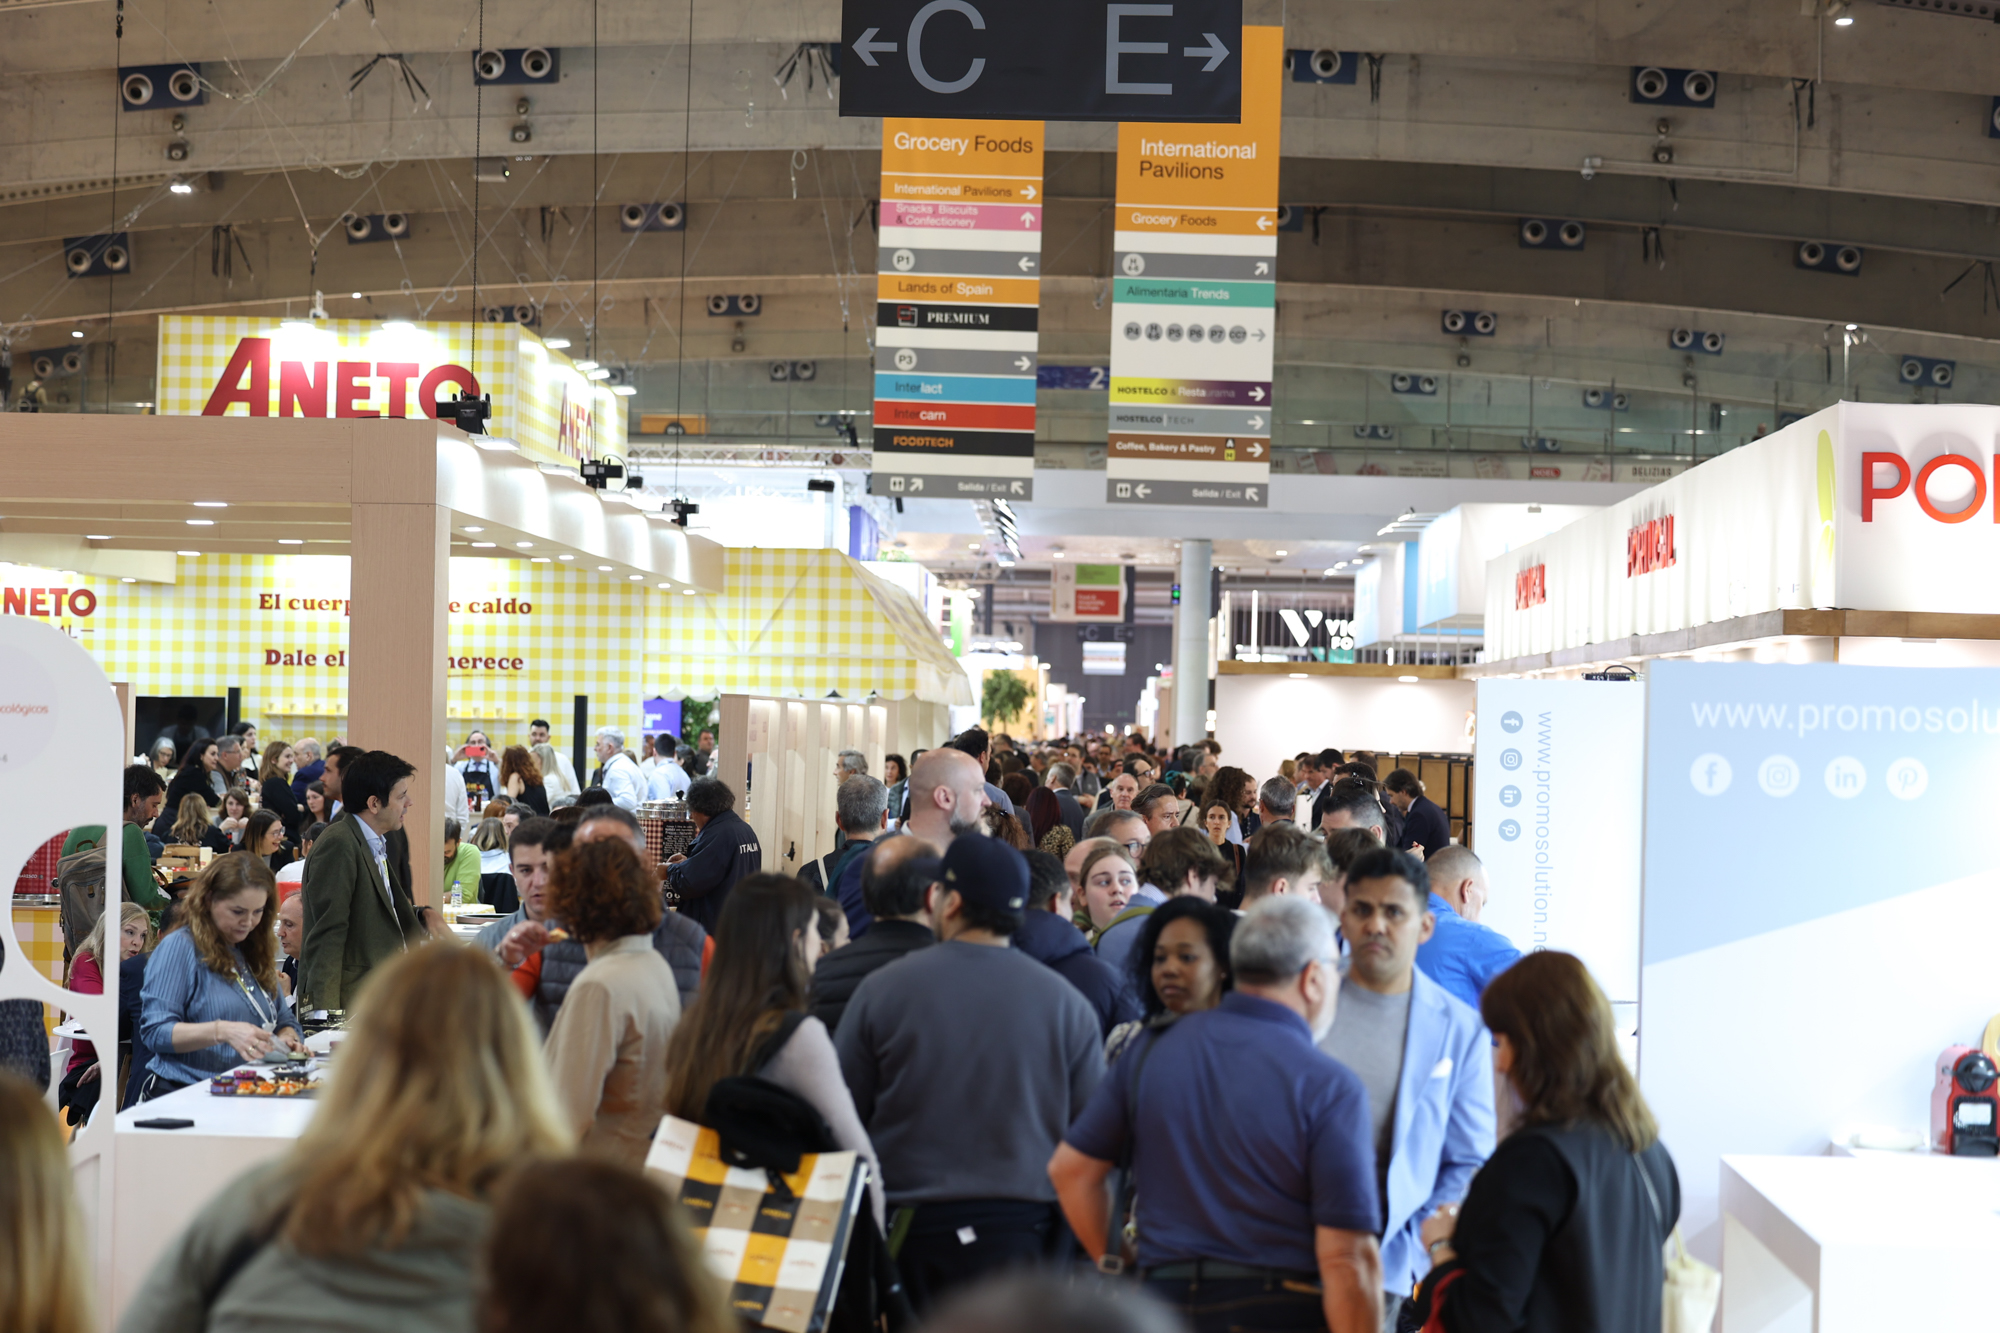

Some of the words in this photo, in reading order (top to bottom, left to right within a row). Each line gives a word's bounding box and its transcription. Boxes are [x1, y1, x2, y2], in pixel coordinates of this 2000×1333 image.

[907, 0, 986, 94] C
[1105, 4, 1174, 95] E
[894, 131, 969, 156] Grocery
[974, 135, 1034, 154] Foods
[1141, 138, 1257, 160] International
[1139, 160, 1224, 180] Pavilions
[894, 183, 961, 196] International
[963, 185, 1013, 197] Pavilions
[938, 204, 978, 216] Biscuits
[905, 215, 976, 229] Confectionery
[1131, 212, 1178, 228] Grocery
[1180, 214, 1217, 227] Foods
[896, 255, 910, 265] P1
[898, 281, 937, 294] Lands
[940, 282, 953, 294] of
[956, 282, 993, 297] Spain
[1126, 285, 1188, 298] Alimentaria
[1191, 287, 1230, 301] Trends
[927, 312, 990, 325] PREMIUM
[1126, 326, 1139, 336] P4
[1168, 328, 1181, 337] P5
[1189, 328, 1203, 338] P6
[1210, 329, 1223, 339] P7
[899, 355, 913, 365] P3
[201, 337, 481, 426] ANETO
[1089, 367, 1105, 389] 2
[895, 382, 943, 395] Interlact
[1118, 386, 1168, 396] HOSTELCO
[894, 408, 947, 421] Intercarn
[1116, 415, 1163, 424] HOSTELCO
[1167, 416, 1194, 425] TECH
[893, 436, 955, 448] FOODTECH
[1116, 441, 1147, 452] Coffee,
[1149, 443, 1178, 454] Bakery
[1188, 444, 1216, 455] Pastry
[957, 482, 985, 492] Salida
[991, 483, 1007, 493] Exit
[1192, 488, 1219, 499] Salida
[1226, 489, 1241, 499] Exit
[259, 594, 281, 610] El
[469, 598, 532, 614] caldo
[265, 649, 317, 666] Dale
[324, 650, 345, 667] el
[740, 843, 758, 854] ITALIA
